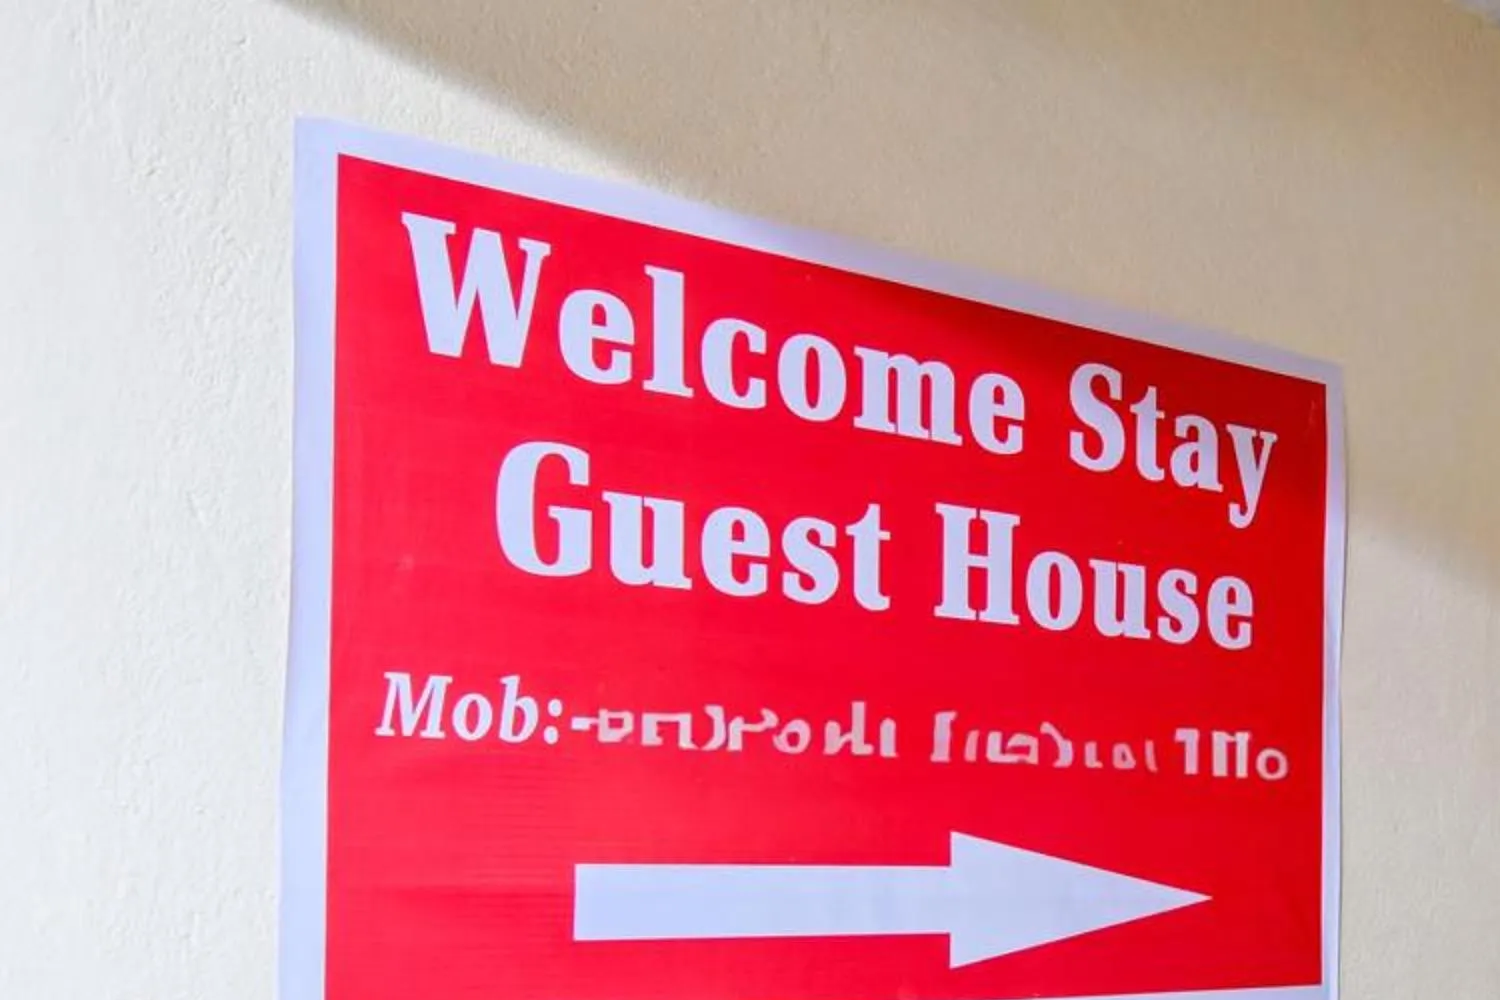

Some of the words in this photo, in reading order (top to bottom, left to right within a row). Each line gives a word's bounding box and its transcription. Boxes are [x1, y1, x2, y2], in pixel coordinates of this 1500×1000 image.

[401, 211, 1025, 455] Welcome
[1068, 362, 1278, 529] Stay
[495, 440, 891, 612] Guest
[933, 501, 1254, 650] House
